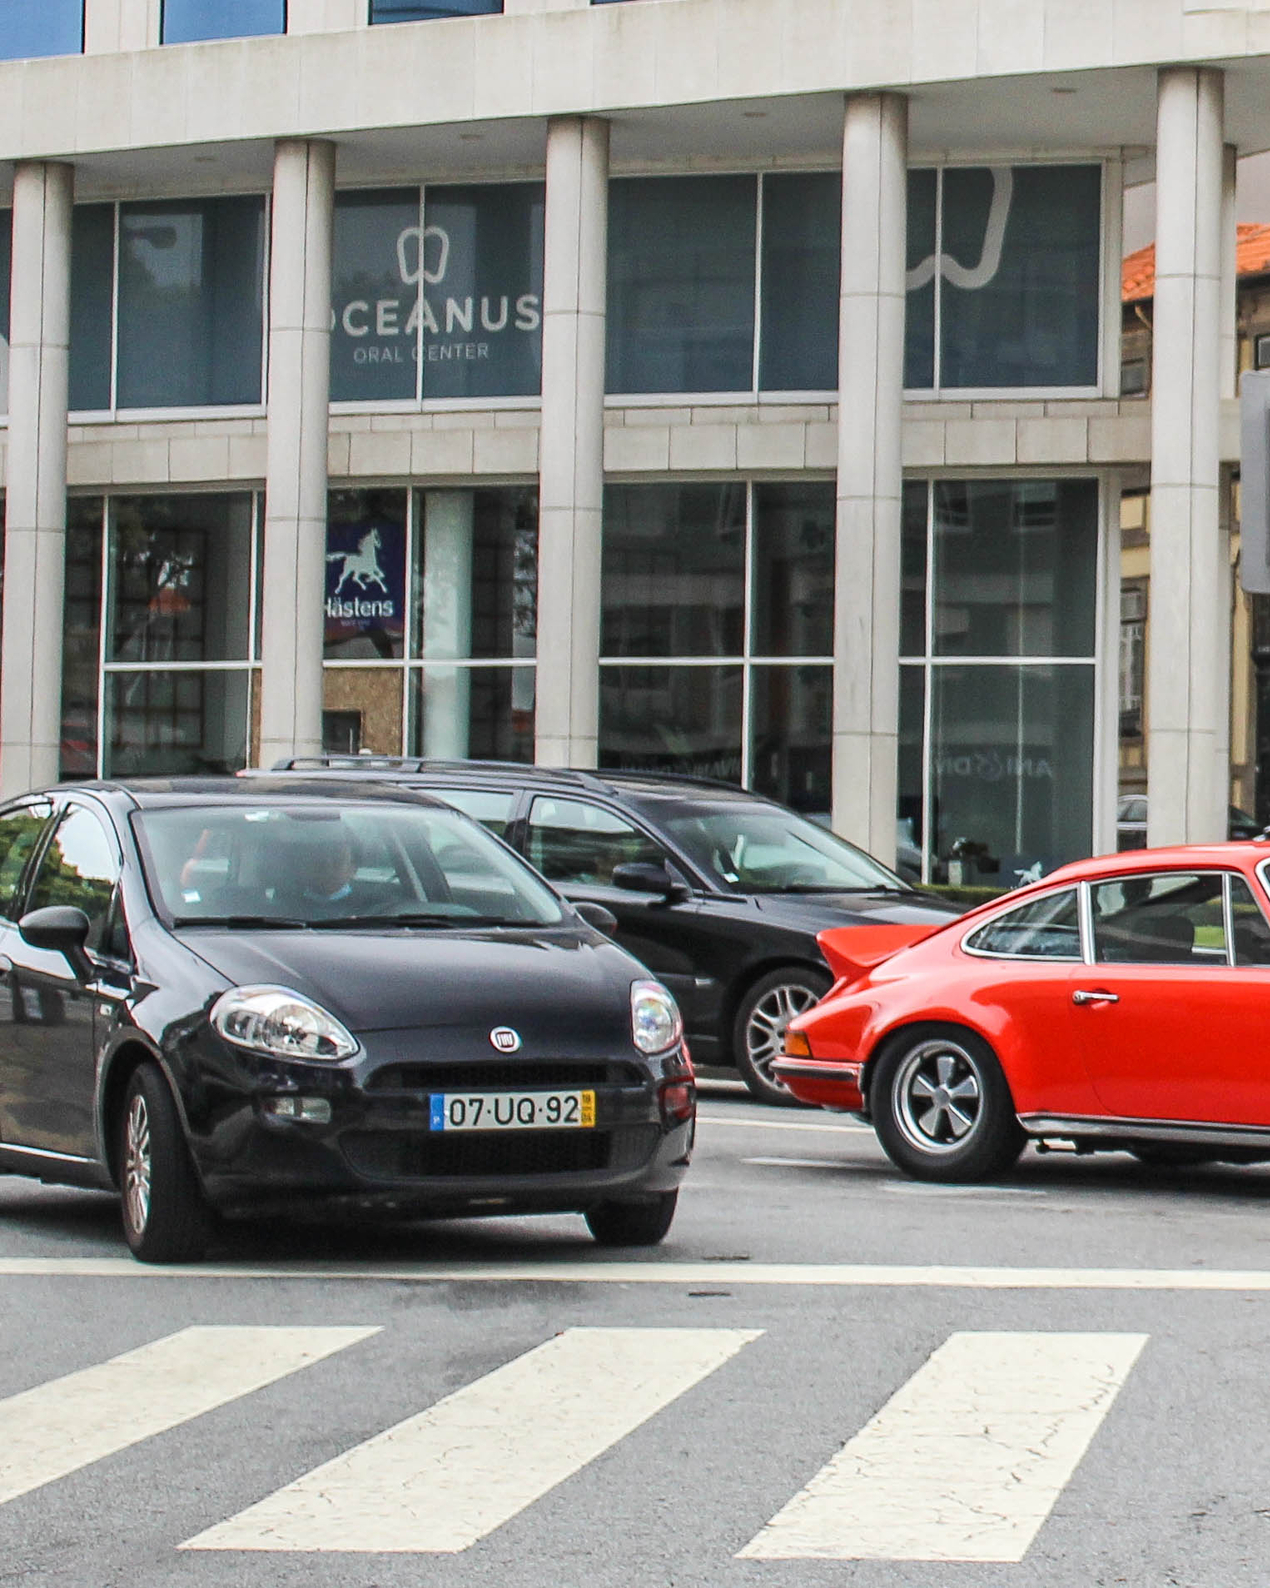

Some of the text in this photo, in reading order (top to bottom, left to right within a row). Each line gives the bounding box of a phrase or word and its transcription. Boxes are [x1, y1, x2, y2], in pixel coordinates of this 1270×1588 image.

[329, 294, 540, 337] CEANUS
[353, 342, 489, 364] ORAL CENTER
